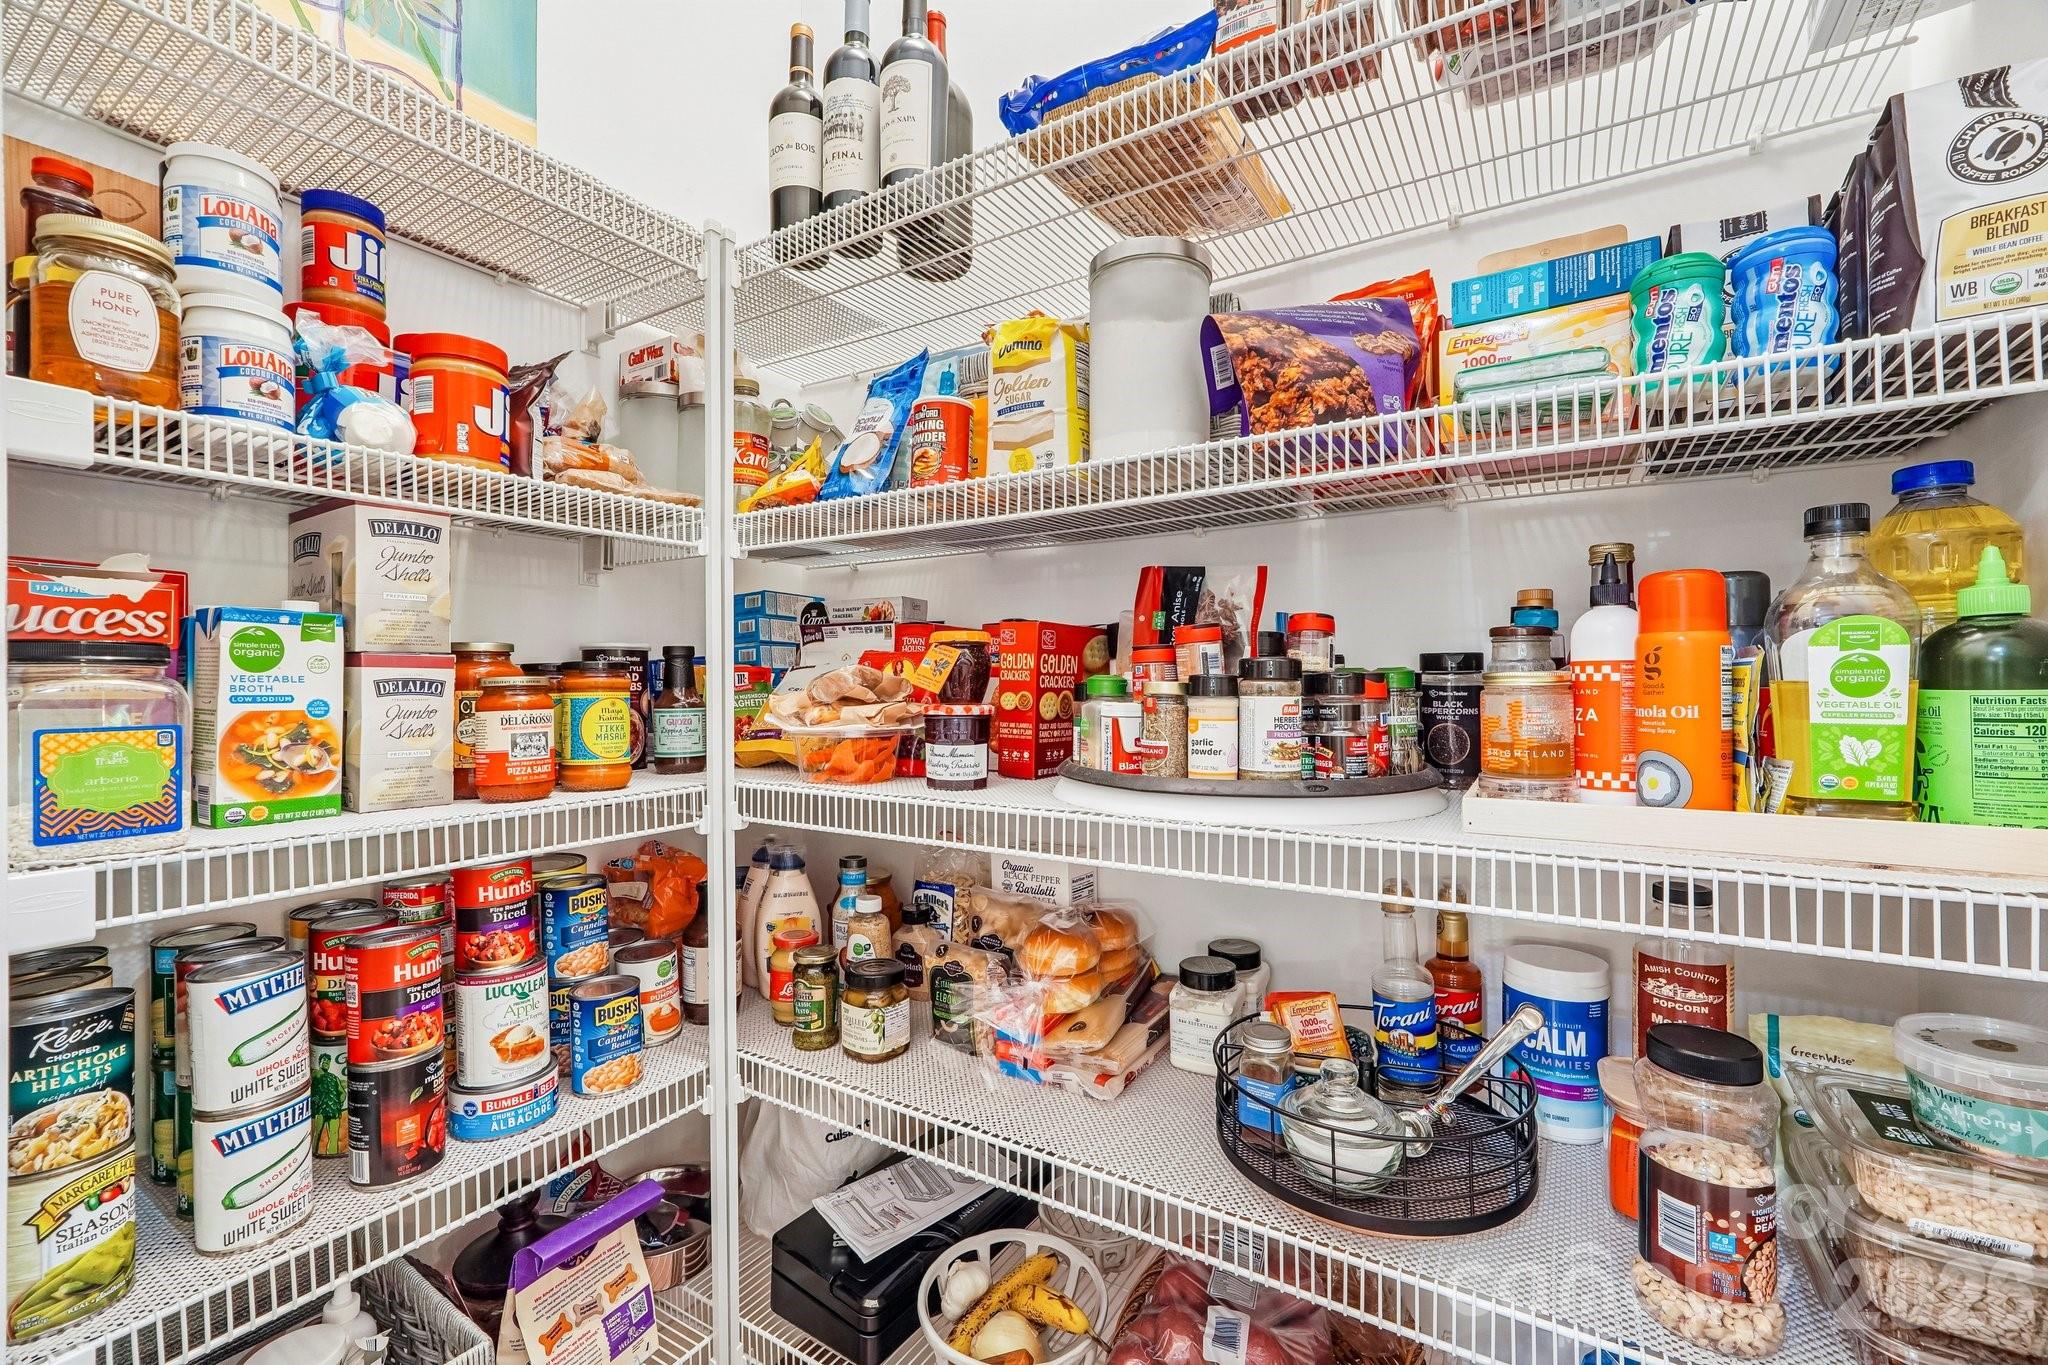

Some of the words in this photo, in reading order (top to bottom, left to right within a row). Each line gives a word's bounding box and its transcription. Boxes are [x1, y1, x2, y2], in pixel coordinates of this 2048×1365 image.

[796, 142, 816, 154] BOIS
[832, 150, 863, 161] FINAL
[1957, 163, 1997, 181] COFFEE
[202, 196, 278, 238] LouAna
[1970, 201, 2047, 229] BREAKFAST
[1986, 220, 2029, 240] BLEND
[1973, 246, 1997, 256] WHOLE
[1999, 241, 2017, 251] BEAN
[2019, 235, 2043, 246] COFFEE
[1767, 257, 1783, 294] Gum
[100, 287, 133, 303] PURE
[1800, 283, 1813, 311] FRESH
[1950, 281, 1978, 299] WB
[92, 298, 141, 318] HONEY
[1774, 263, 1801, 353] mentos
[1675, 306, 1689, 333] FRESH
[1651, 288, 1677, 373] mentos
[223, 347, 293, 384] LouAna
[628, 349, 646, 368] Gulf
[1462, 354, 1497, 369] 1000
[994, 374, 1051, 405] Golden
[1005, 391, 1031, 405] SUGAR
[373, 520, 438, 541] DELALLO
[375, 546, 434, 570] Jumbo
[380, 562, 433, 583] Shells
[1172, 590, 1183, 620] Anise
[7, 604, 168, 637] uccess
[902, 637, 925, 645] TOWN
[233, 648, 281, 658] organic
[1000, 653, 1034, 670] GOLDEN
[1040, 653, 1078, 674] GOLDEN
[231, 675, 305, 684] VEGETABLE
[1000, 670, 1030, 681] CRACKERS
[1040, 675, 1075, 688] CRACKERS
[1834, 673, 1886, 683] organic
[229, 685, 273, 693] BROTH
[378, 680, 443, 699] DELALLO
[1643, 689, 1665, 697] Gather
[256, 695, 292, 703] SODIUM
[1816, 701, 1881, 709] VEGETABLE
[1884, 702, 1902, 710] OIL
[1973, 697, 2017, 705] Nutrition
[2020, 697, 2047, 705] Facts
[380, 704, 437, 730] Jumbo
[1421, 707, 1478, 716] PEPPERCORNS
[1671, 705, 1699, 719] Oil
[1928, 706, 1941, 717] Oil
[387, 721, 435, 740] Shells
[596, 732, 627, 741] MASALA
[599, 724, 625, 732] TIKKA
[1974, 727, 2015, 736] Calories
[2025, 725, 2047, 736] 120
[1191, 738, 1213, 748] garlic
[1191, 748, 1222, 757] powder
[1487, 748, 1564, 758] BRIGHTLAND
[507, 766, 532, 775] PIZZA
[533, 763, 551, 773] SAUCE
[85, 775, 138, 786] arborio
[1001, 859, 1034, 876] Organic
[1003, 870, 1029, 881] BLACK
[1031, 874, 1060, 885] PEPPER
[478, 880, 531, 902] Hunt's
[1015, 881, 1056, 898] Barilotti
[505, 901, 528, 911] Roasted
[571, 892, 608, 911] BUSH'S
[492, 906, 526, 923] Diced
[503, 922, 519, 930] Garlic
[583, 927, 602, 938] Beans
[407, 985, 421, 993] Fire
[410, 985, 441, 1004] Diced
[485, 982, 527, 1001] LUCKY
[527, 973, 546, 995] LEAF
[421, 1002, 436, 1011] Garlic
[504, 1000, 540, 1019] Apple
[597, 999, 639, 1024] BUSH'S
[1292, 1003, 1327, 1014] Emergen-C
[1653, 998, 1709, 1014] POPCORN
[1300, 1017, 1318, 1028] 1000
[1374, 1001, 1431, 1031] Torani
[29, 1018, 109, 1058] Reese
[266, 1019, 301, 1047] SHOEPEG
[1299, 1026, 1327, 1037] Vitamin
[1327, 1024, 1334, 1032] C
[611, 1038, 632, 1050] Beans
[1523, 1025, 1587, 1057] CALM
[10, 1044, 127, 1083] ARTICHOKE
[46, 1045, 100, 1063] CHOPPED
[1521, 1050, 1591, 1071] GUMMIES
[1791, 1045, 1853, 1066] GreenWise
[256, 1056, 291, 1077] WHOLE
[1556, 1071, 1590, 1079] Supplement
[32, 1064, 112, 1093] HEARTS
[230, 1074, 274, 1104] WHITE
[278, 1058, 308, 1084] SWEET
[485, 1089, 532, 1112] BUMBLE
[539, 1078, 555, 1094] BEE
[490, 1103, 551, 1132] ALBACORE
[492, 1109, 516, 1121] CHUNK
[517, 1103, 537, 1115] WHITE
[1941, 1103, 2035, 1136] Almonds
[259, 1157, 298, 1191] SHOEPEG
[50, 1166, 117, 1212] MARGARET
[557, 1170, 592, 1212] WILDERNESS
[248, 1199, 286, 1220] WHOLE
[959, 1199, 984, 1221] ANOVA
[1755, 1215, 1768, 1223] DRY
[223, 1217, 266, 1247] WHITE
[270, 1198, 307, 1225] SWEET
[56, 1232, 97, 1254] Italian
[100, 1219, 126, 1240] Green
[618, 1326, 646, 1351] WELLNESS
